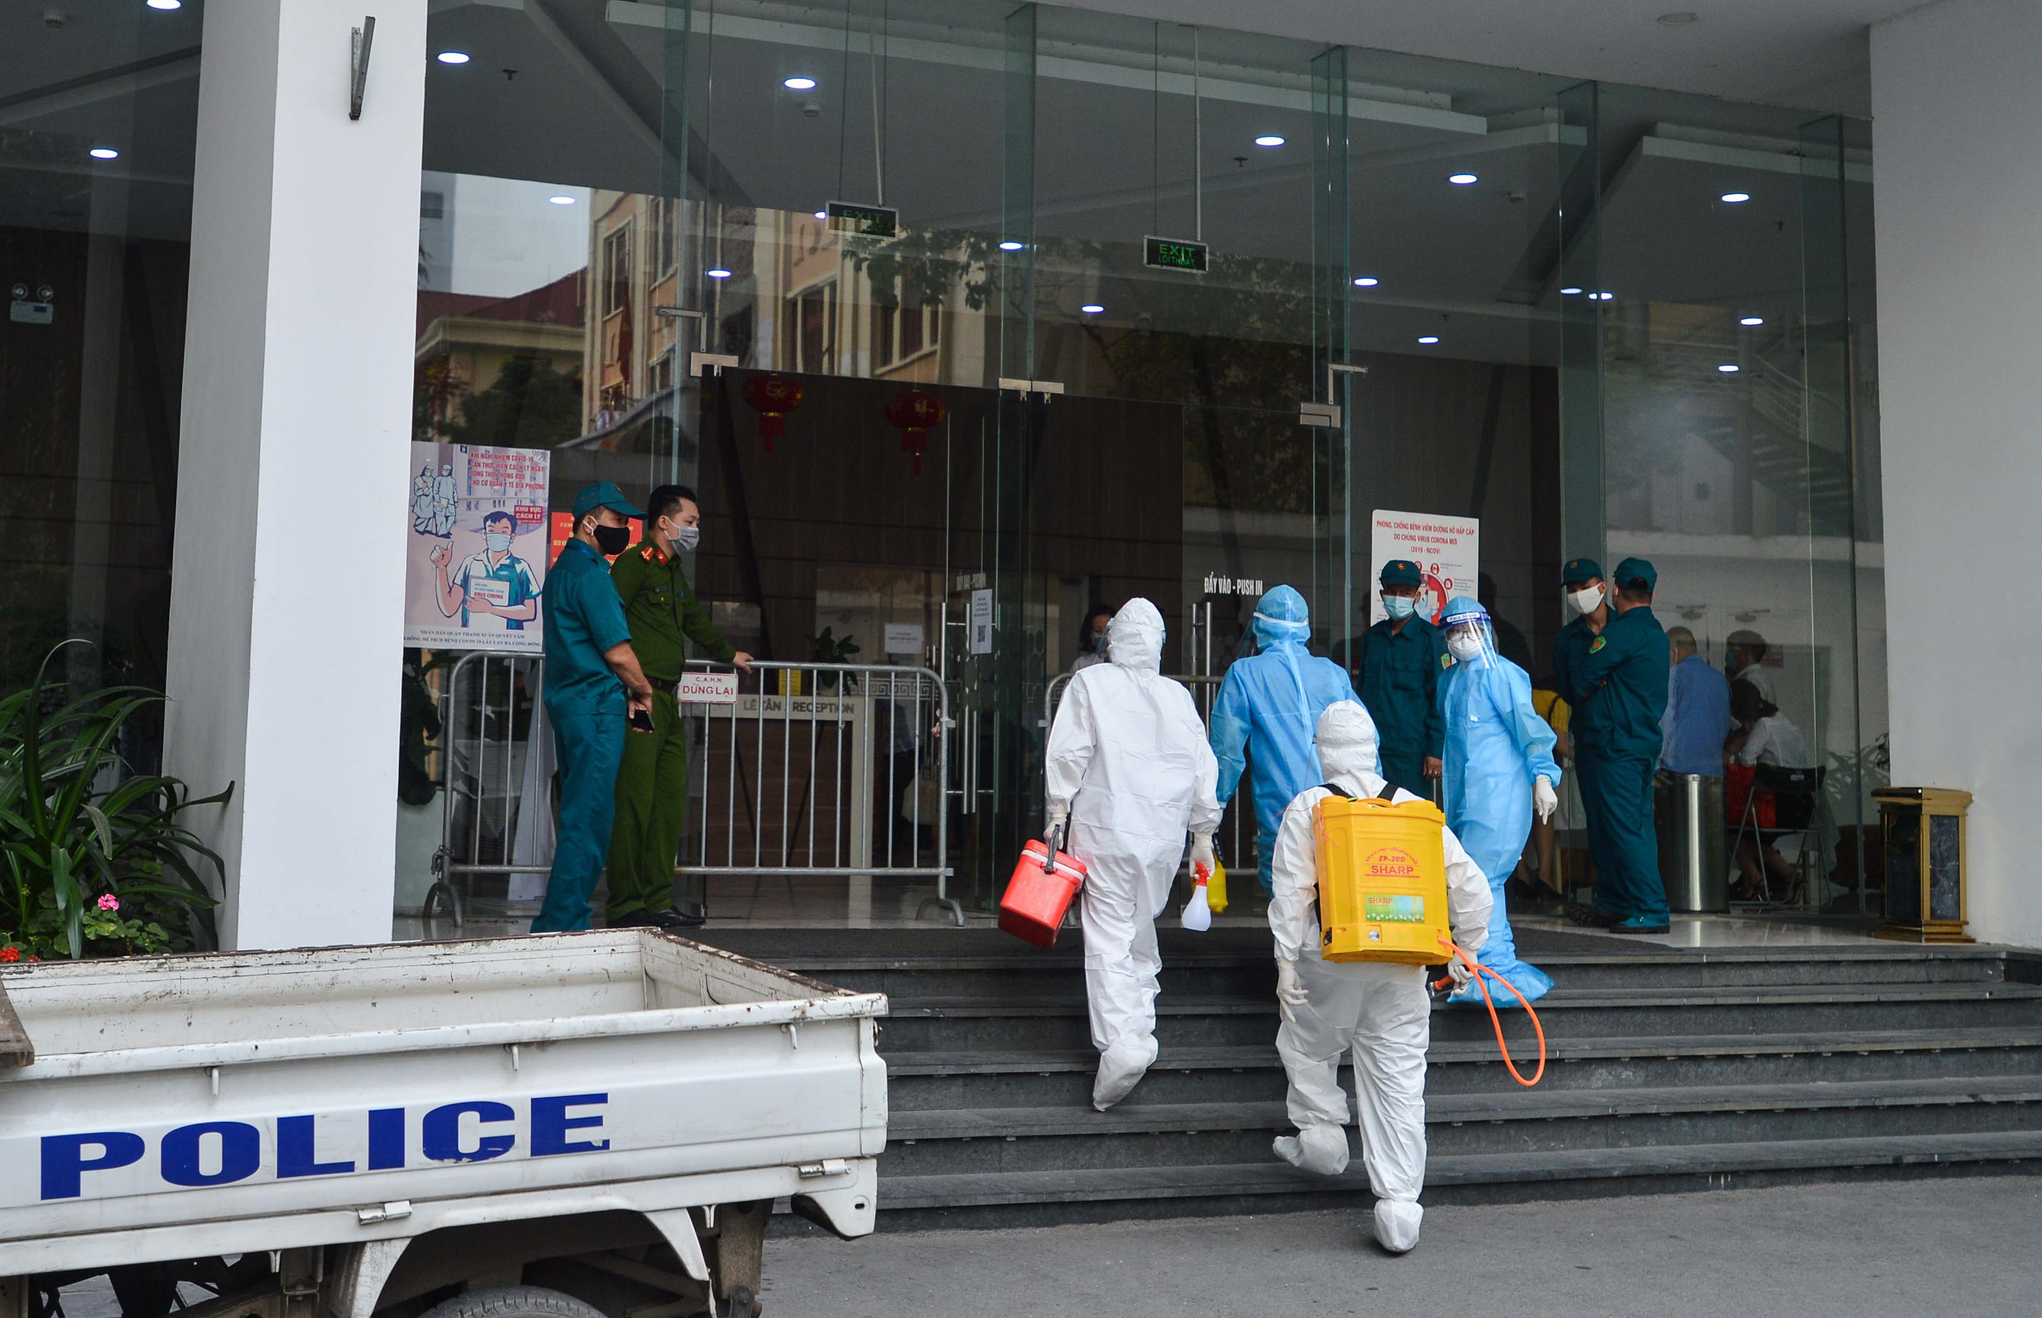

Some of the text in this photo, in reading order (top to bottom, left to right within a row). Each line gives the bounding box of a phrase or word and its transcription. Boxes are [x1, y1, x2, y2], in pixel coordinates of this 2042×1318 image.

[843, 210, 880, 223] EXIT
[1160, 244, 1195, 258] EXIT
[1431, 536, 1448, 544] CORONA
[1204, 571, 1217, 594] ĐẨY
[1218, 575, 1232, 595] VÀO
[1236, 578, 1254, 596] PUSH
[1255, 580, 1263, 596] IN
[682, 683, 734, 698] DỪNG LẠI
[792, 701, 854, 714] RECEPTION
[1371, 865, 1414, 875] SHARP
[41, 1092, 610, 1200] POLICE
